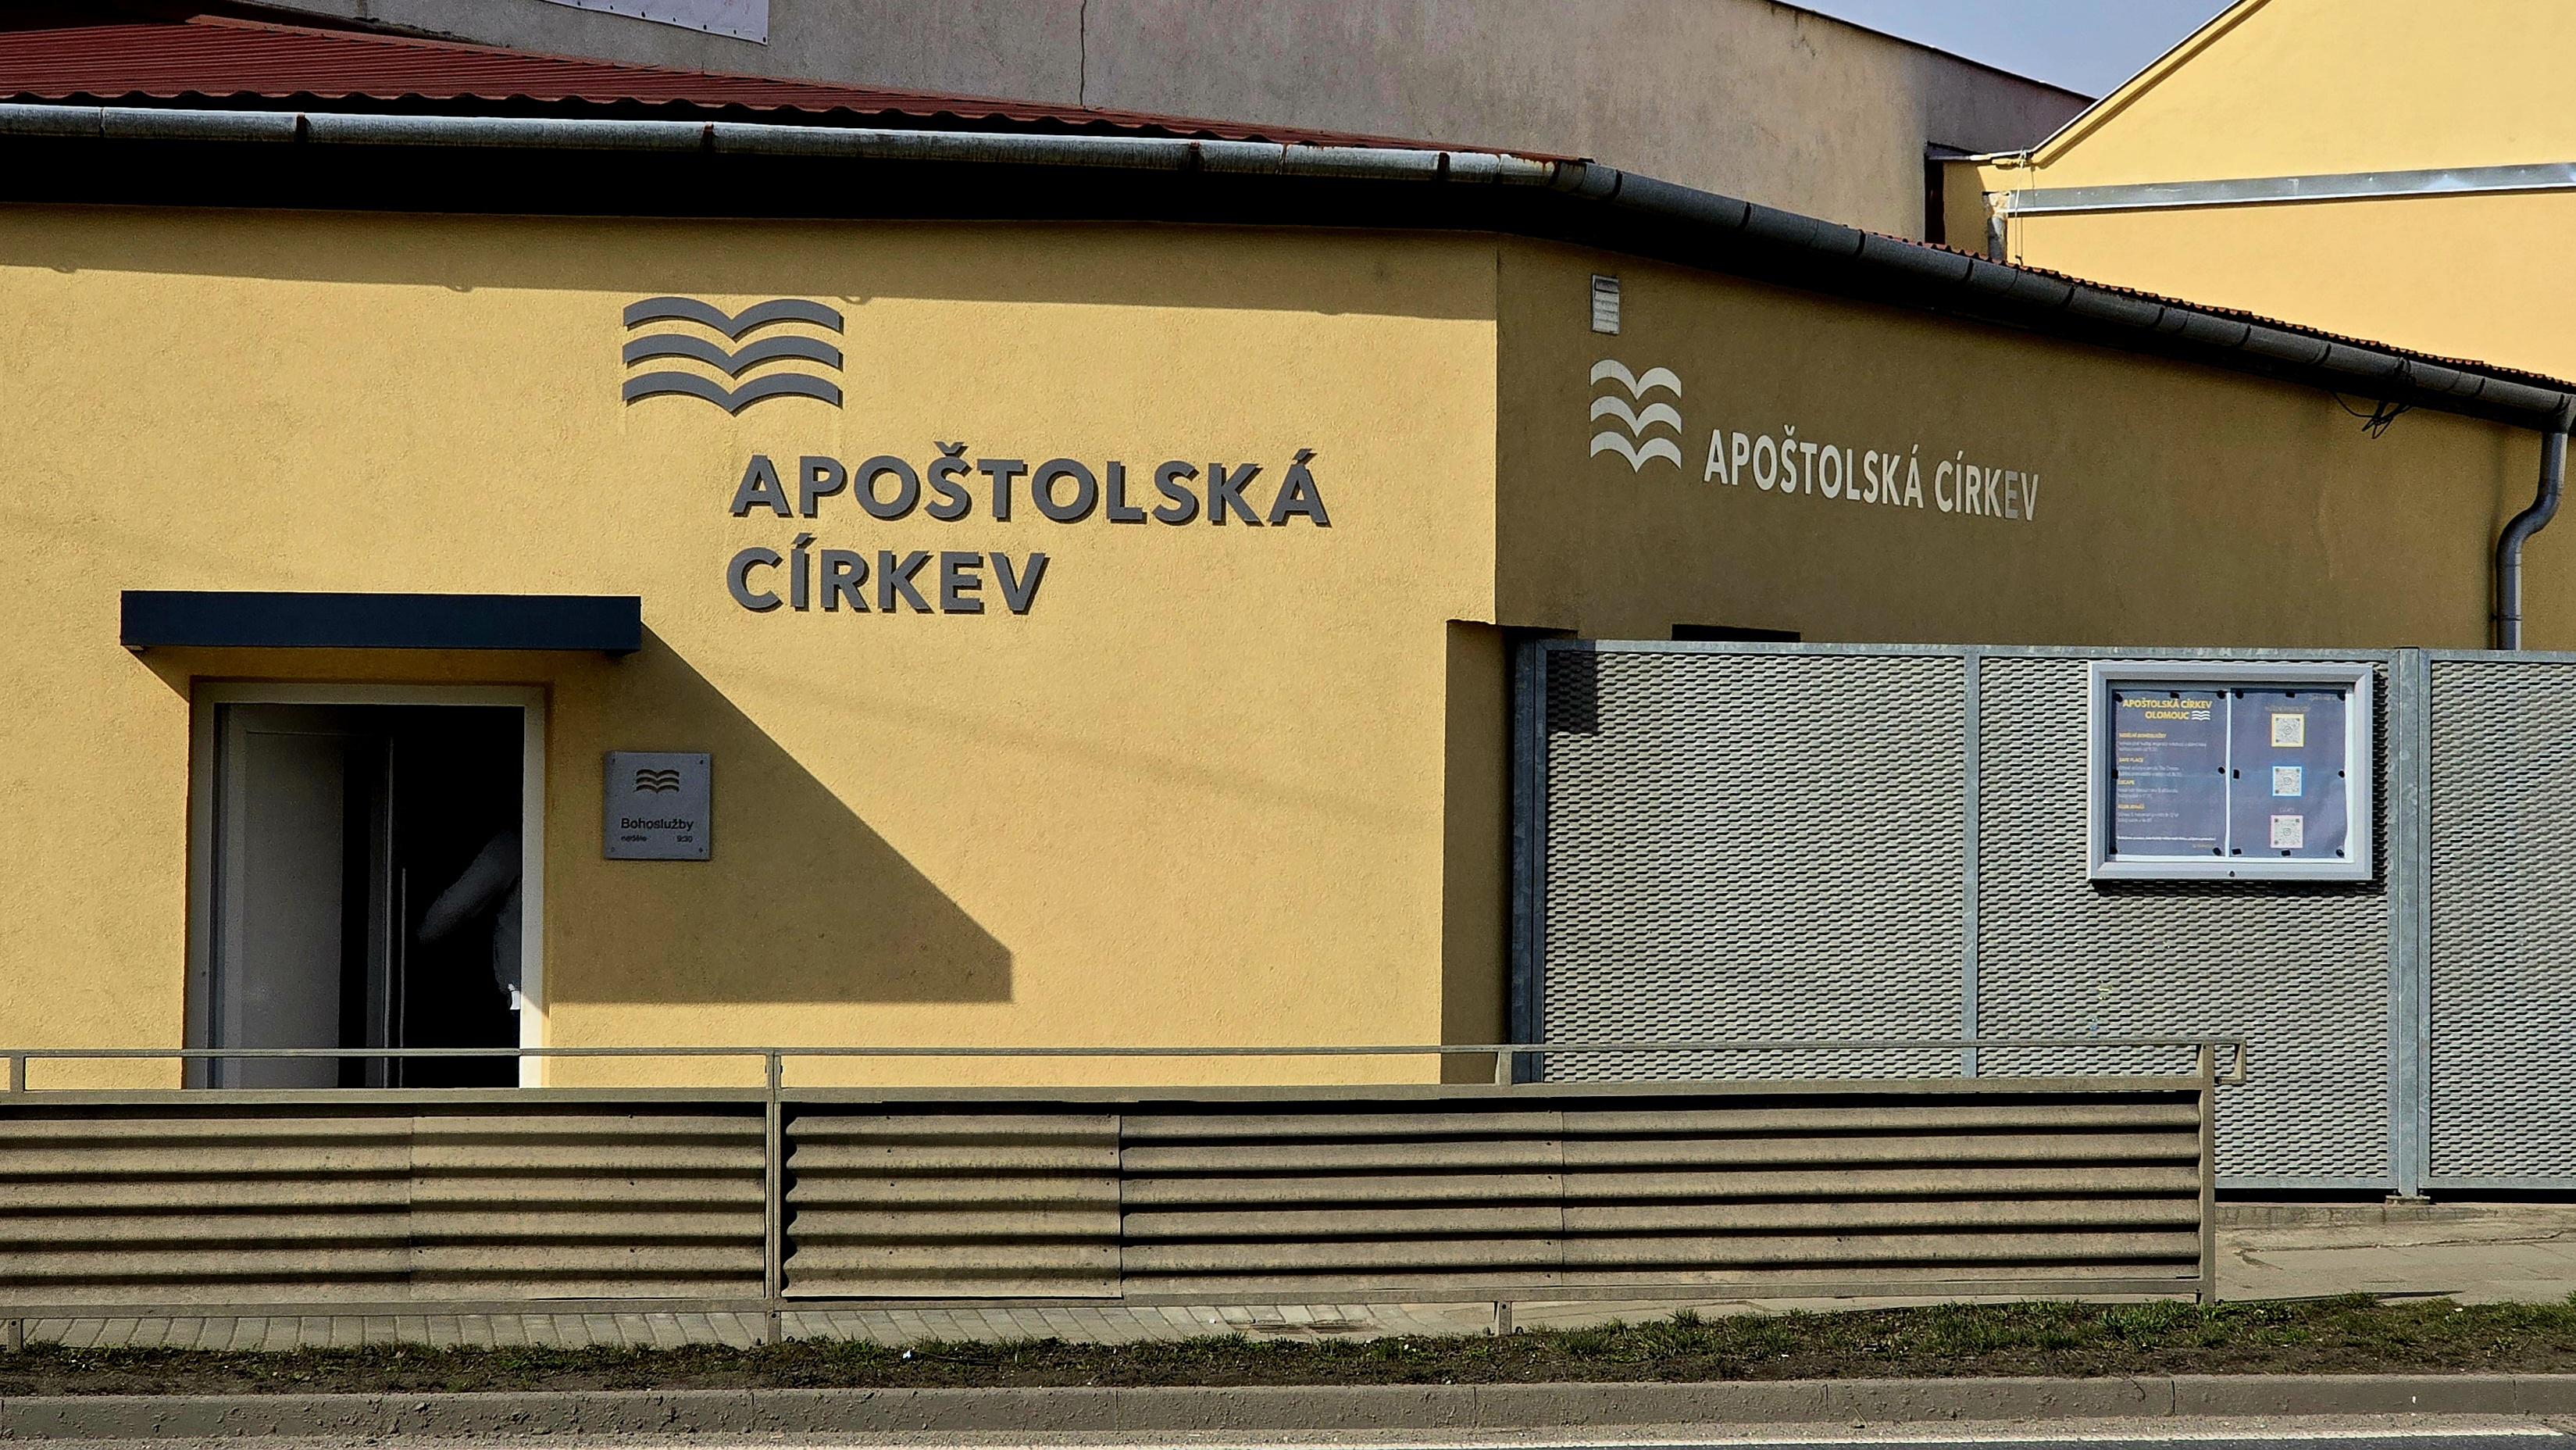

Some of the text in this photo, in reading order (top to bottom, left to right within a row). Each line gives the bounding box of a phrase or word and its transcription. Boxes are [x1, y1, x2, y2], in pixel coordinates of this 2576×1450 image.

[729, 441, 1331, 528] APOŠTOLSKÁ
[1704, 424, 2039, 520] APOŠTOLSKÁ CÍRKEV
[726, 533, 1050, 614] CÍRKEV
[2122, 698, 2212, 709] APOŠTOLSKÁ CÍRKEV
[2145, 711, 2190, 720] OLOMOUC
[621, 817, 694, 831] Bohoslužby
